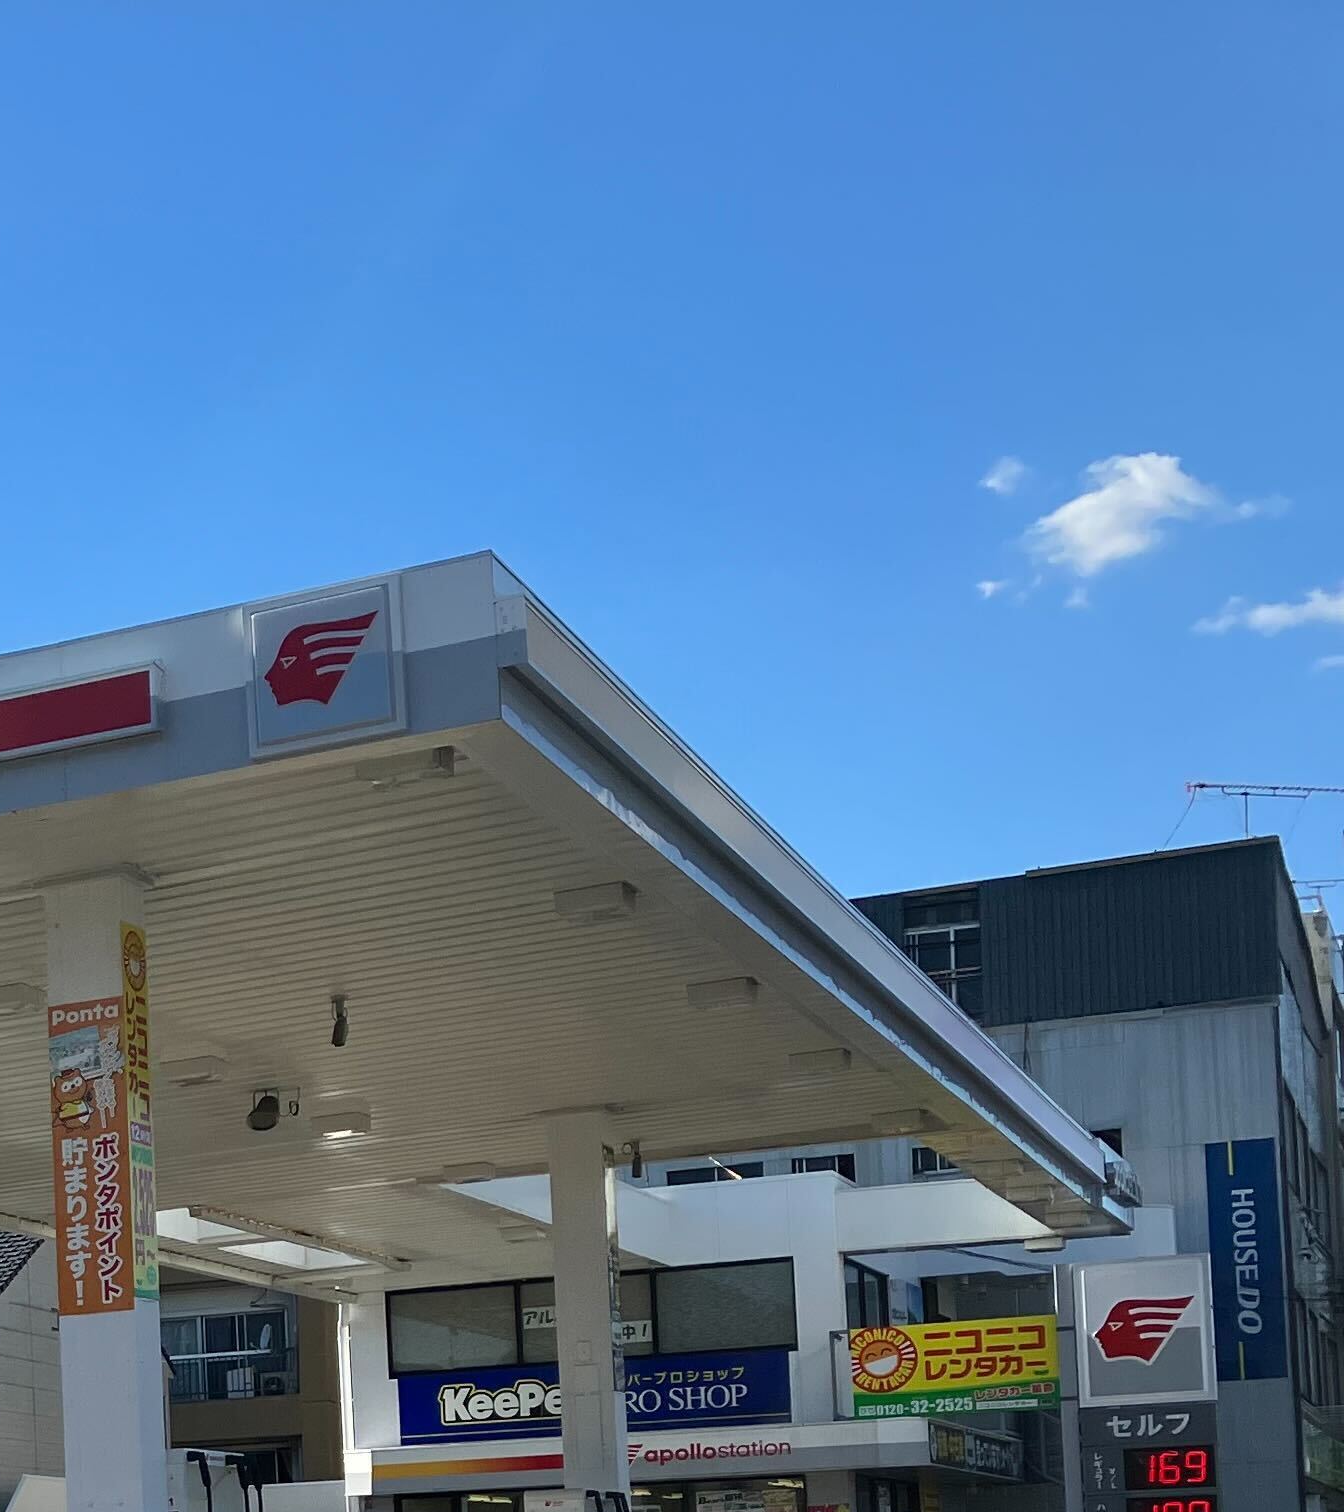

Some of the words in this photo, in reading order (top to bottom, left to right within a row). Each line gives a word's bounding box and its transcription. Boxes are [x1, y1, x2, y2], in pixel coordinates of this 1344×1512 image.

[51, 1003, 119, 1027] Ponta
[61, 1137, 90, 1307] 貯まります!
[92, 1131, 121, 1305] ポンタポイント
[924, 1324, 1047, 1357] ニコニコ
[924, 1354, 1048, 1381] レンタカー
[443, 1382, 562, 1422] KeePe
[624, 1390, 661, 1413] RO
[668, 1384, 748, 1412] SHOP
[876, 1397, 973, 1416] 0120-32-2525
[1105, 1413, 1190, 1438] セルフ
[643, 1439, 792, 1467] apollostation
[1147, 1451, 1208, 1484] 169
